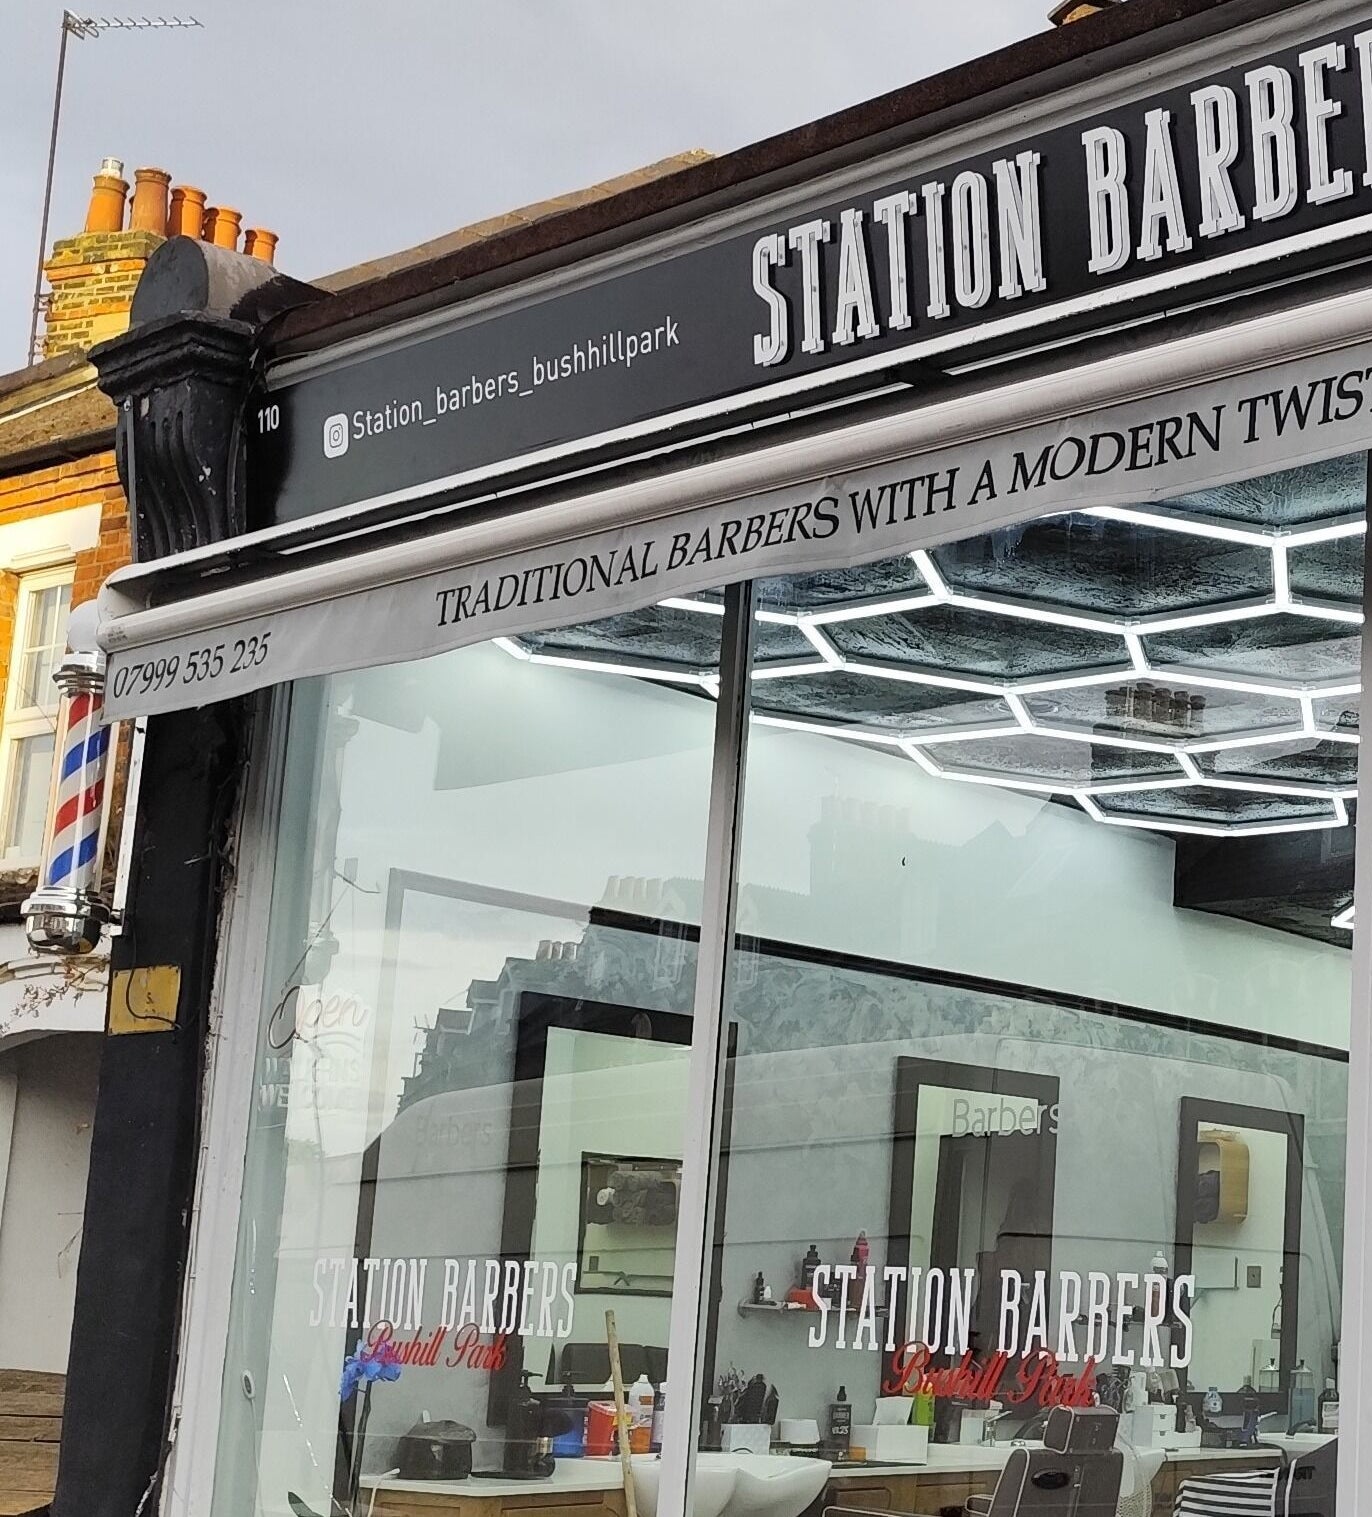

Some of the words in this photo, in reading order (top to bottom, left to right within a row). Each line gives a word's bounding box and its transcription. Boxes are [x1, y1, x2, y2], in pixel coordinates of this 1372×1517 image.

[752, 150, 1046, 367] STATION
[352, 316, 680, 440] Station_barbers_bushhillpark
[258, 405, 280, 434] 110
[436, 541, 659, 627] TRADITIONAL
[666, 497, 840, 570] BARBERS
[848, 468, 960, 533] WITH
[967, 465, 998, 504] A
[1009, 405, 1223, 495] MODERN
[113, 656, 181, 698] 07999
[182, 644, 226, 684] 535
[229, 632, 272, 674] 235
[309, 1257, 428, 1331] STATION
[440, 1259, 578, 1338] BARBERS
[808, 1264, 976, 1355] STATION
[997, 1269, 1197, 1369] BARBERS
[360, 1319, 448, 1367] Bushill
[446, 1322, 507, 1370] Park
[882, 1341, 1009, 1400] Bushill
[1007, 1347, 1099, 1408] Park
